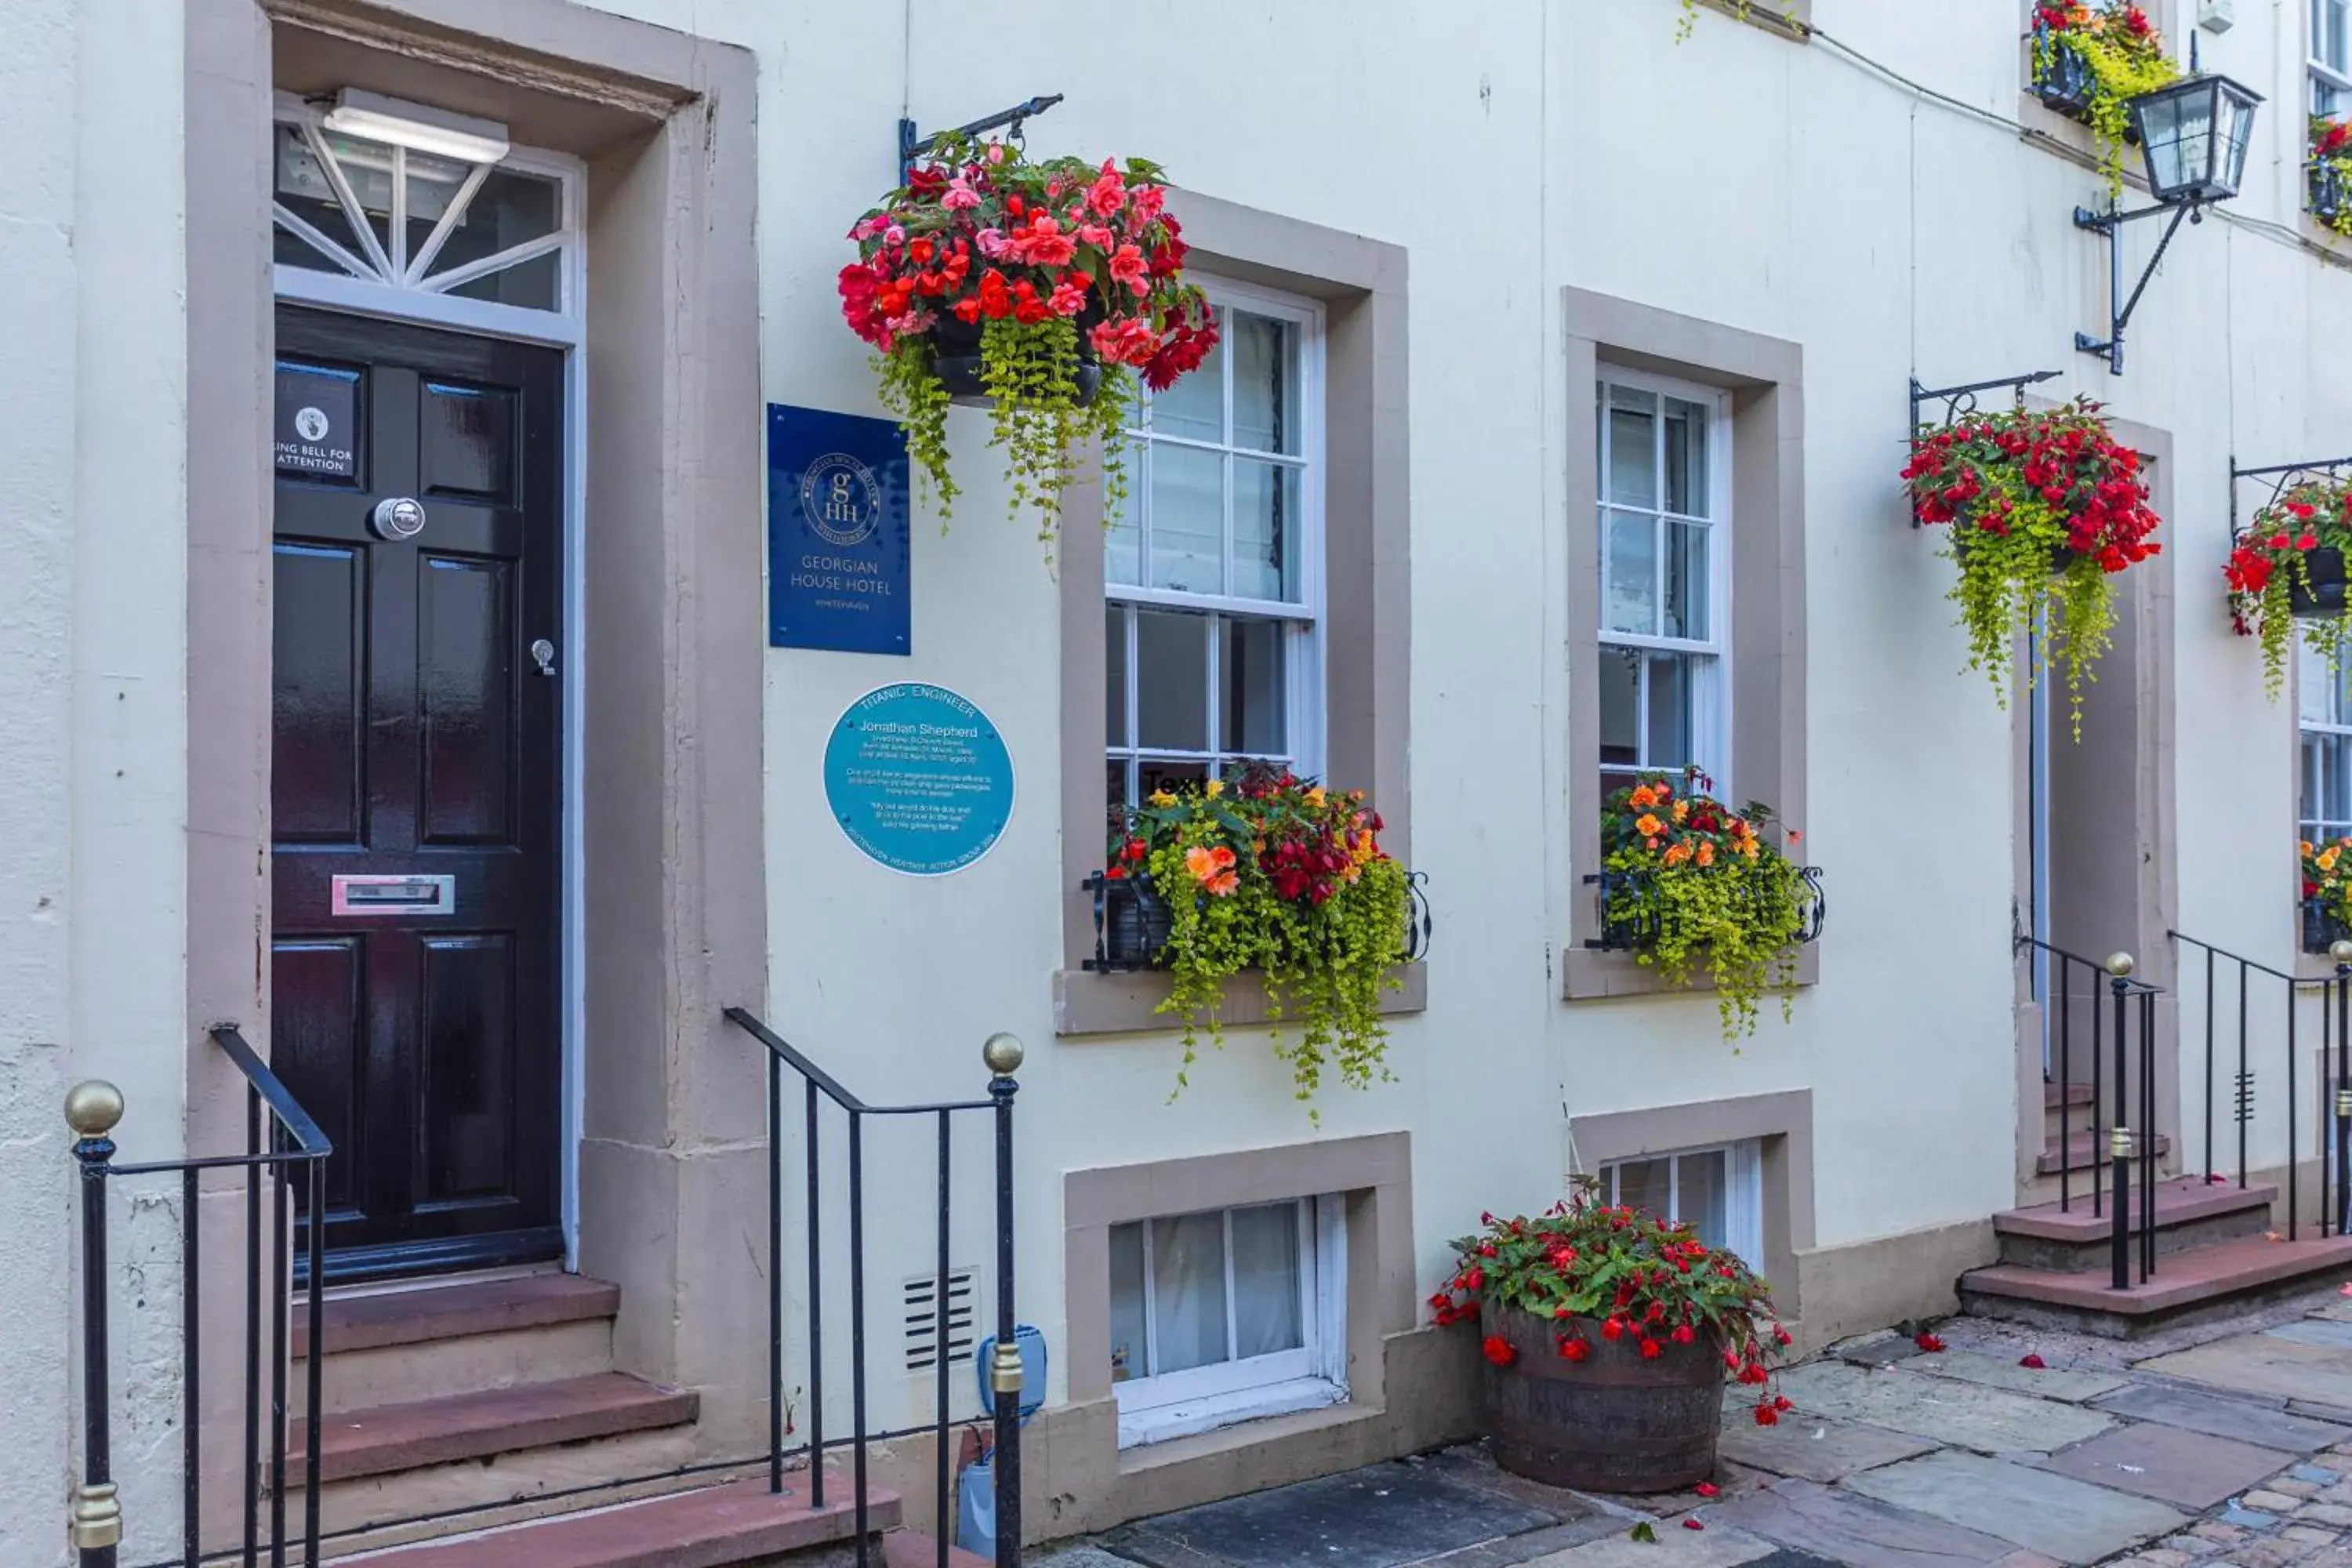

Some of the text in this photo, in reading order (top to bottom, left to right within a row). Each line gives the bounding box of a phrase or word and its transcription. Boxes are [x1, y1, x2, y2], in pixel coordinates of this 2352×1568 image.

[274, 442, 352, 461] ING BELL FOR
[277, 454, 344, 470] ATTENTION
[826, 503, 857, 522] HH
[802, 554, 877, 575] GEORGIAN
[790, 572, 891, 595] HOUSE HOTEL
[861, 686, 975, 719] TITANIC ENGINEER
[860, 720, 978, 739] Jonathan Shepherd
